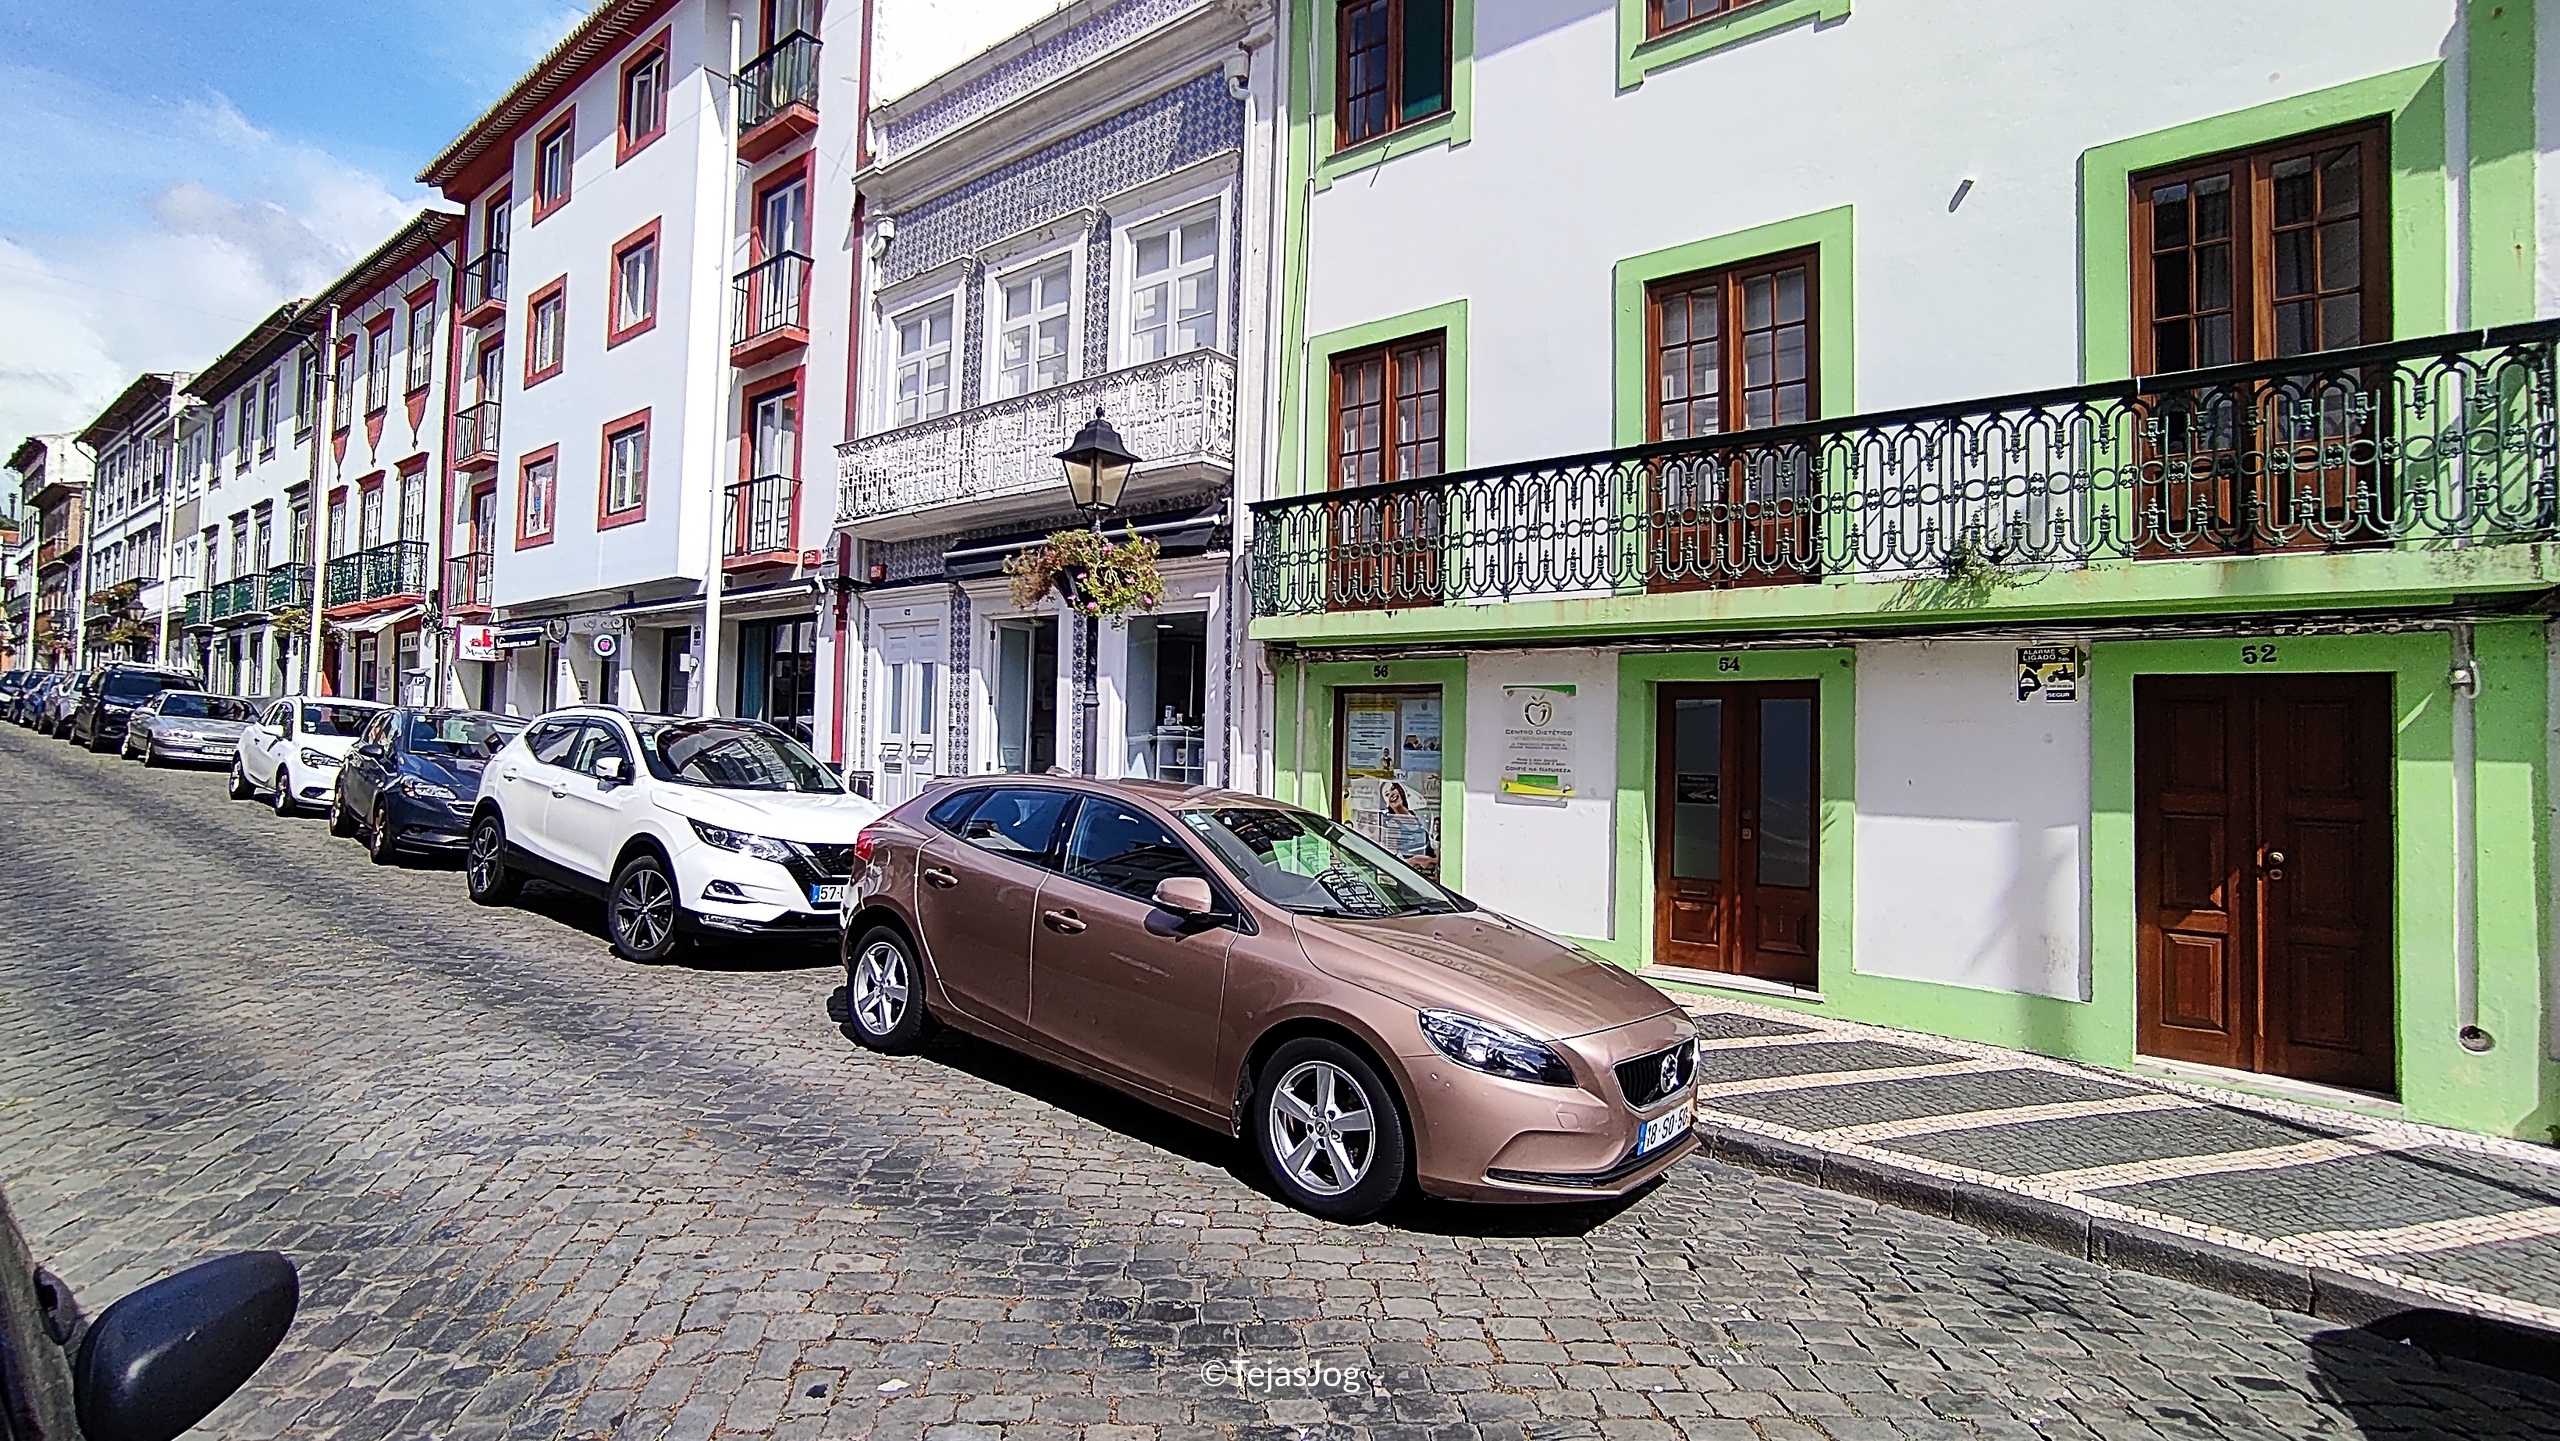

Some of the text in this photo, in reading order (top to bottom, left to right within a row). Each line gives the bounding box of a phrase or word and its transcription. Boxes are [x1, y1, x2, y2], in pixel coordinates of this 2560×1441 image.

[2241, 643, 2278, 665] 52
[1373, 664, 1389, 678] 56
[1718, 656, 1740, 672] 54
